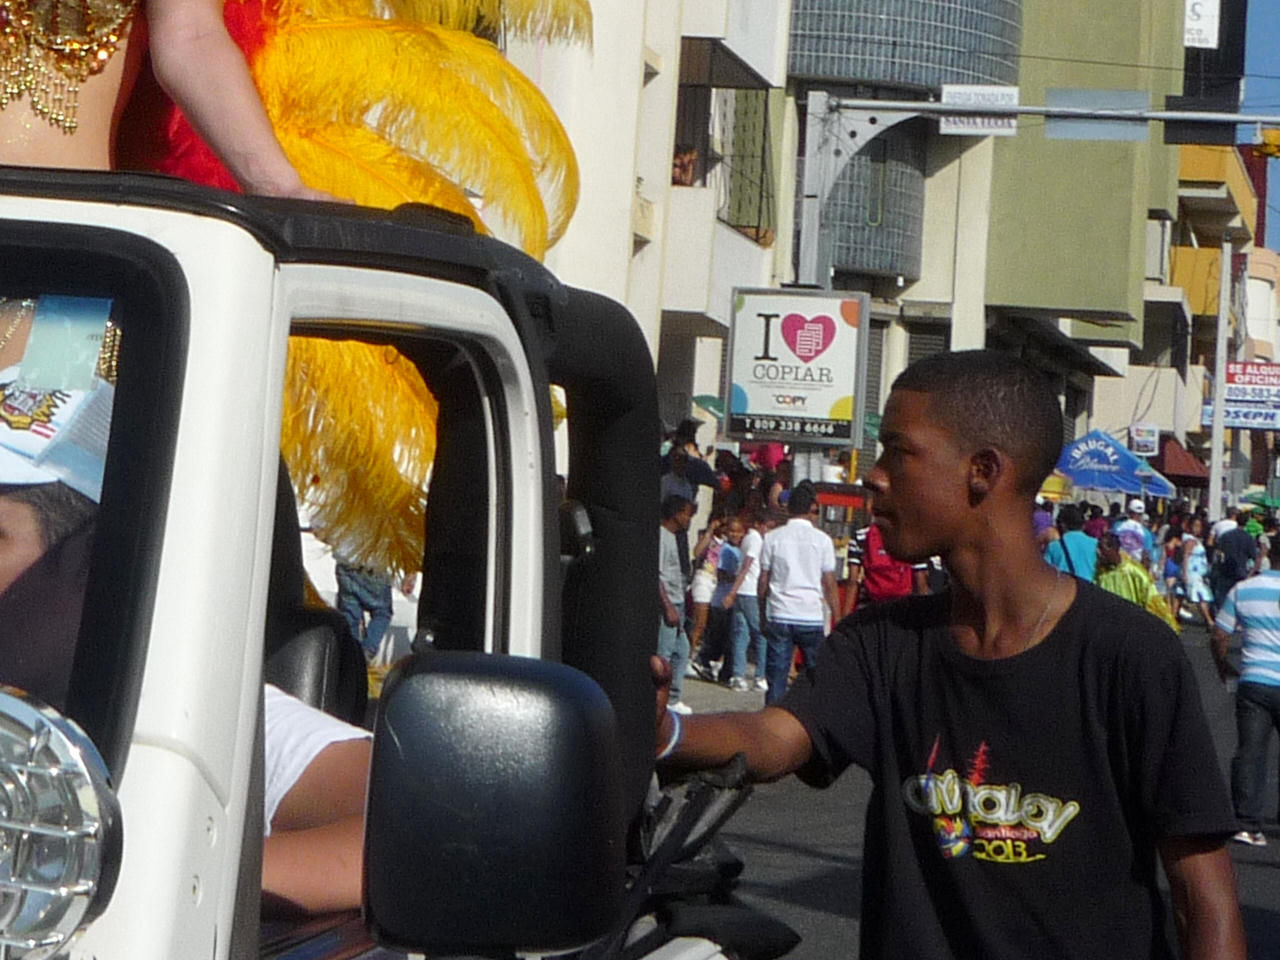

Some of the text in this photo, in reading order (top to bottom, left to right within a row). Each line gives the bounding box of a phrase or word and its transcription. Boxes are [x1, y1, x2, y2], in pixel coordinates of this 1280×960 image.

[753, 313, 780, 361] I
[752, 364, 834, 383] COPIAR
[1228, 363, 1244, 374] SE
[776, 394, 808, 406] COPY
[754, 419, 776, 430] 809
[1071, 439, 1119, 464] BRUGAL
[973, 840, 1027, 859] 2013
